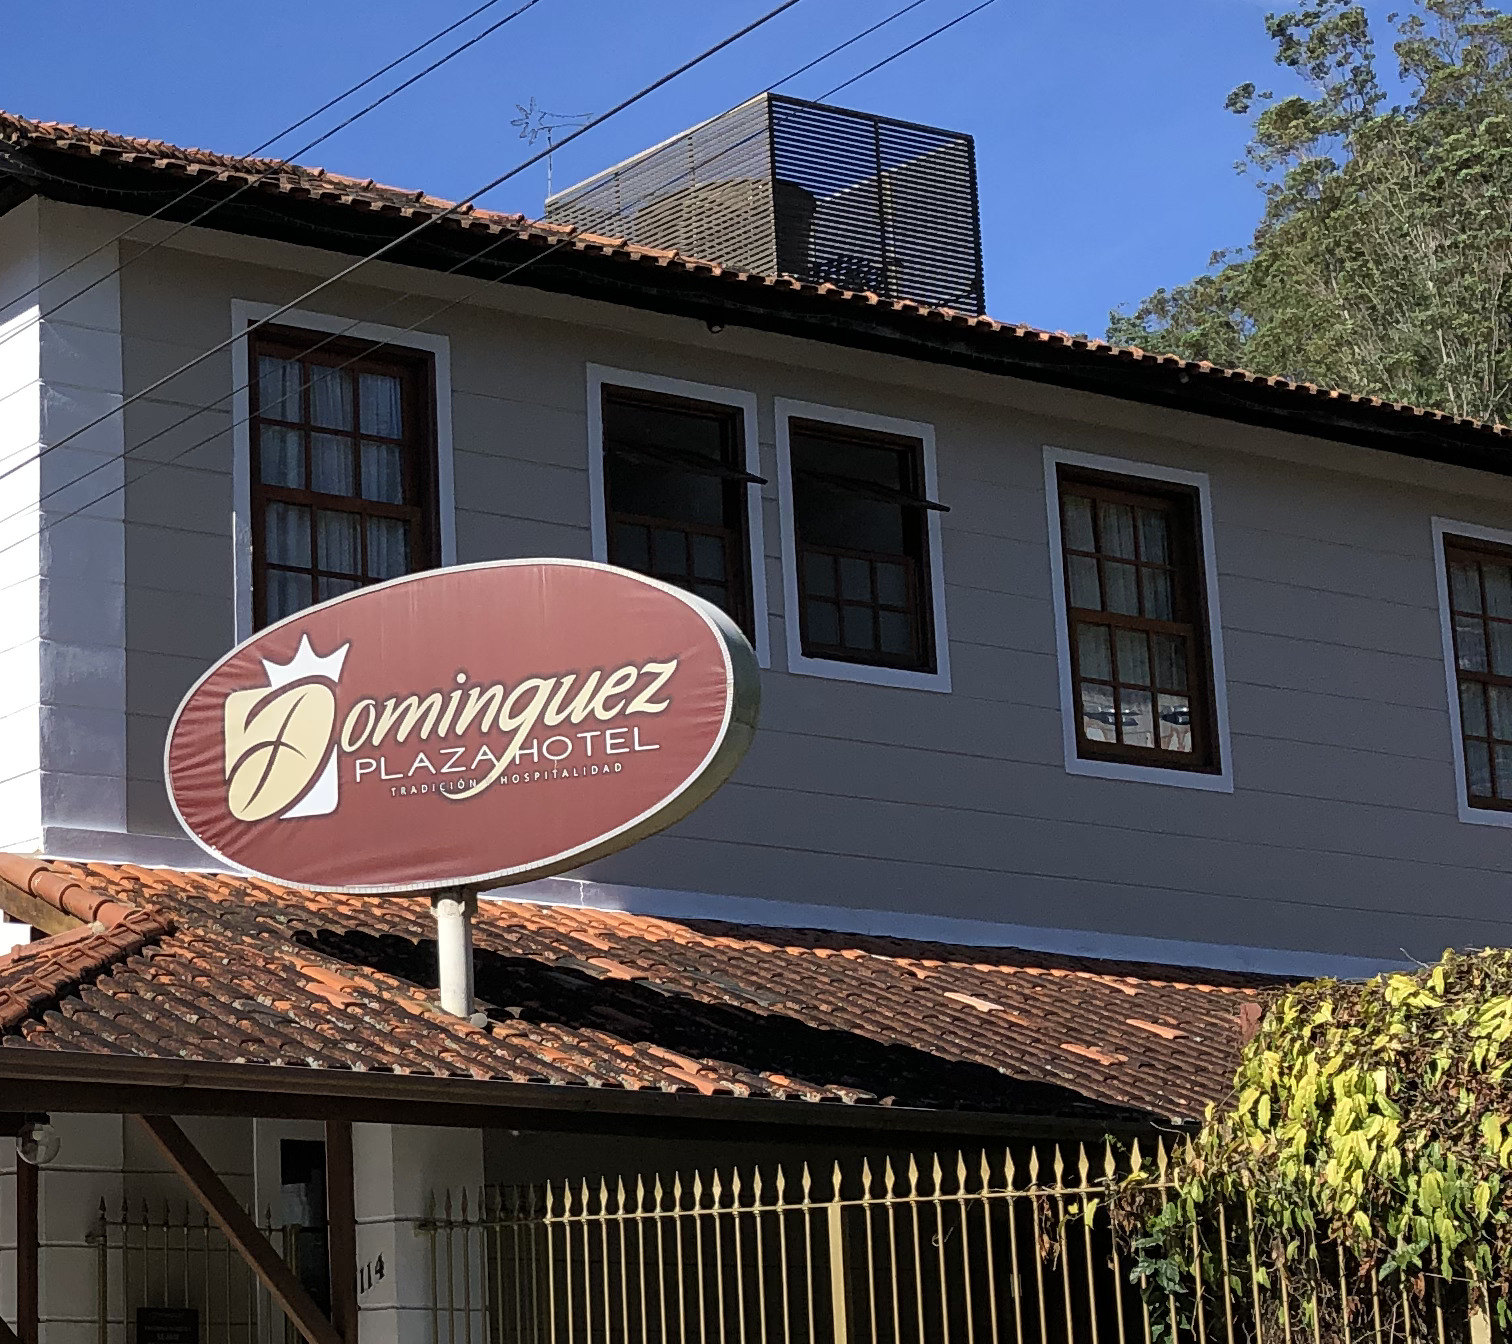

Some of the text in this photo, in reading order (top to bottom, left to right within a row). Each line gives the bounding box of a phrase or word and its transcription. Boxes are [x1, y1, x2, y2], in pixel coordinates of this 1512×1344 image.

[226, 659, 678, 821] Dominguez
[355, 726, 660, 782] PLAZA HOTEL
[390, 777, 478, 797] TRADICIÓN
[500, 762, 623, 785] HOSPITALIDAD
[360, 1250, 385, 1295] 114
